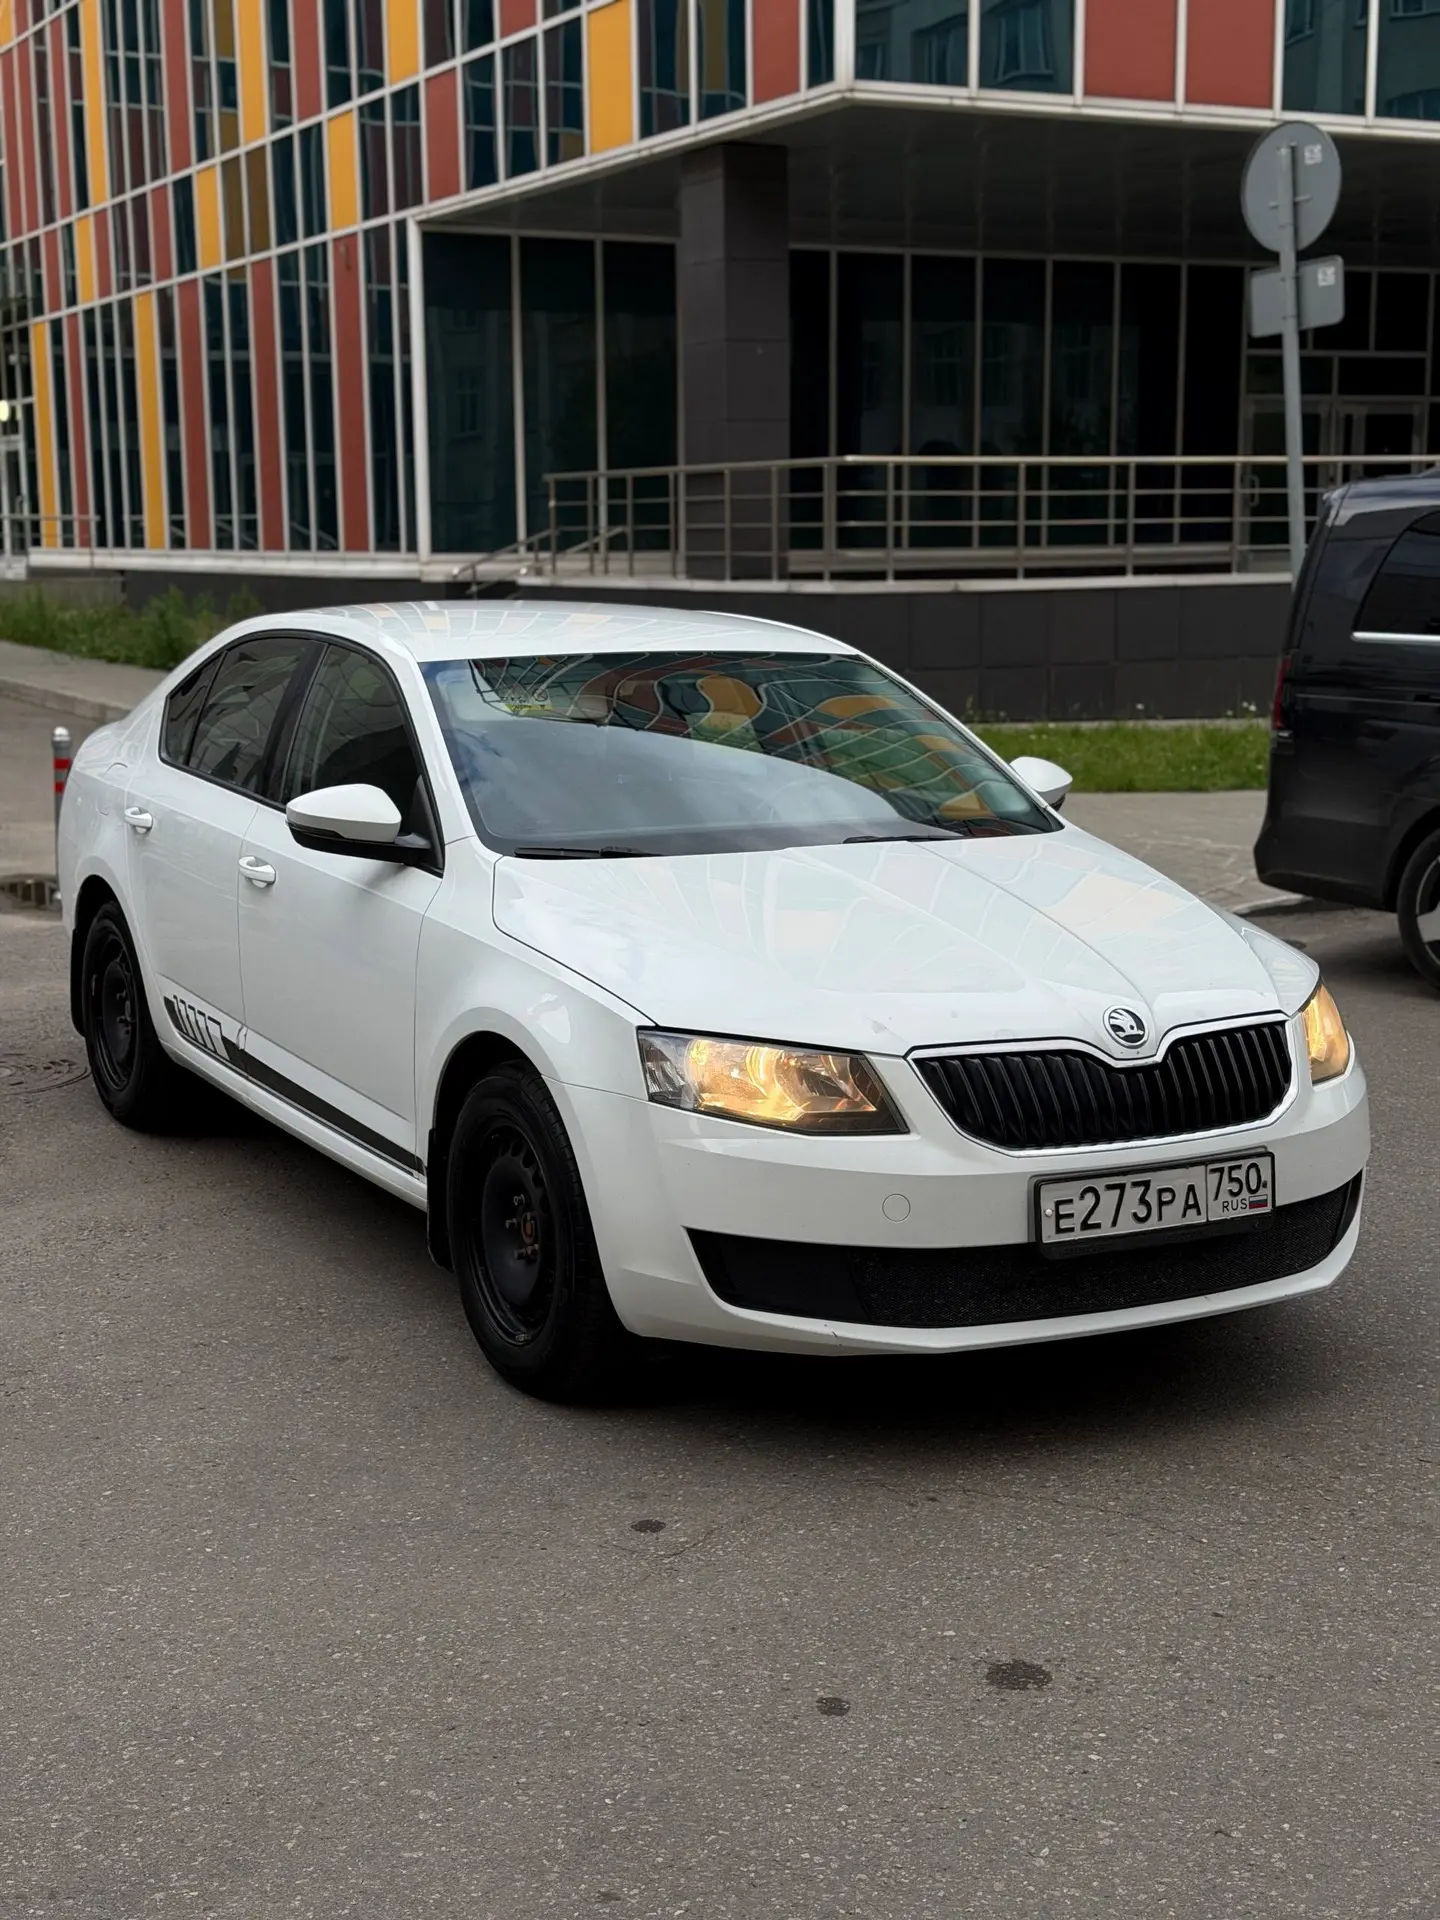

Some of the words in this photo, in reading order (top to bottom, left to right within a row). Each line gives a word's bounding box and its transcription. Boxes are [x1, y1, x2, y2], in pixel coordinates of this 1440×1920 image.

[1054, 1179, 1202, 1235] Е273РА
[1209, 1162, 1262, 1201] 750
[1222, 1198, 1248, 1213] RUS
